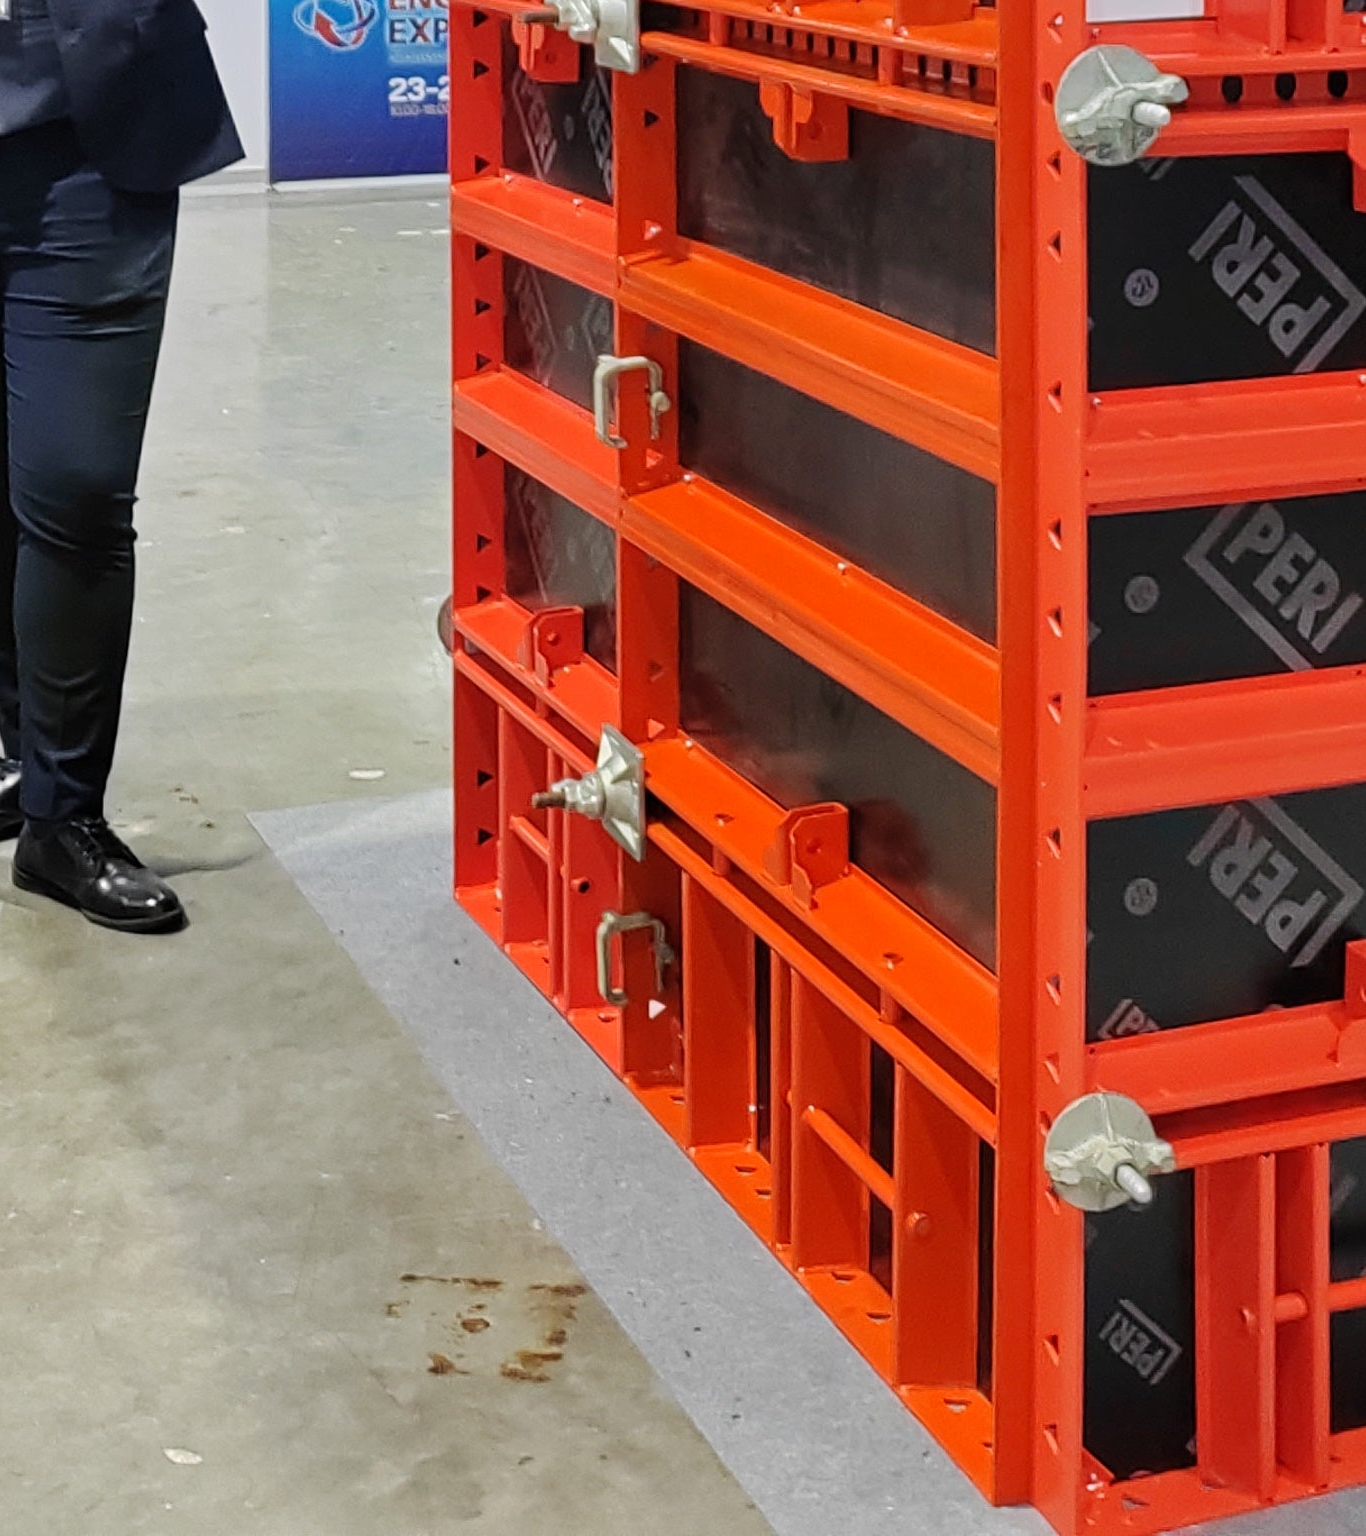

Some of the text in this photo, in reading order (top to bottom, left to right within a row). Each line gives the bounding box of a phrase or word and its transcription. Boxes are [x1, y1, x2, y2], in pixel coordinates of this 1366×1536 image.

[1188, 200, 1332, 359] PERI
[1222, 502, 1365, 655] PERI
[1186, 804, 1328, 953] PERI
